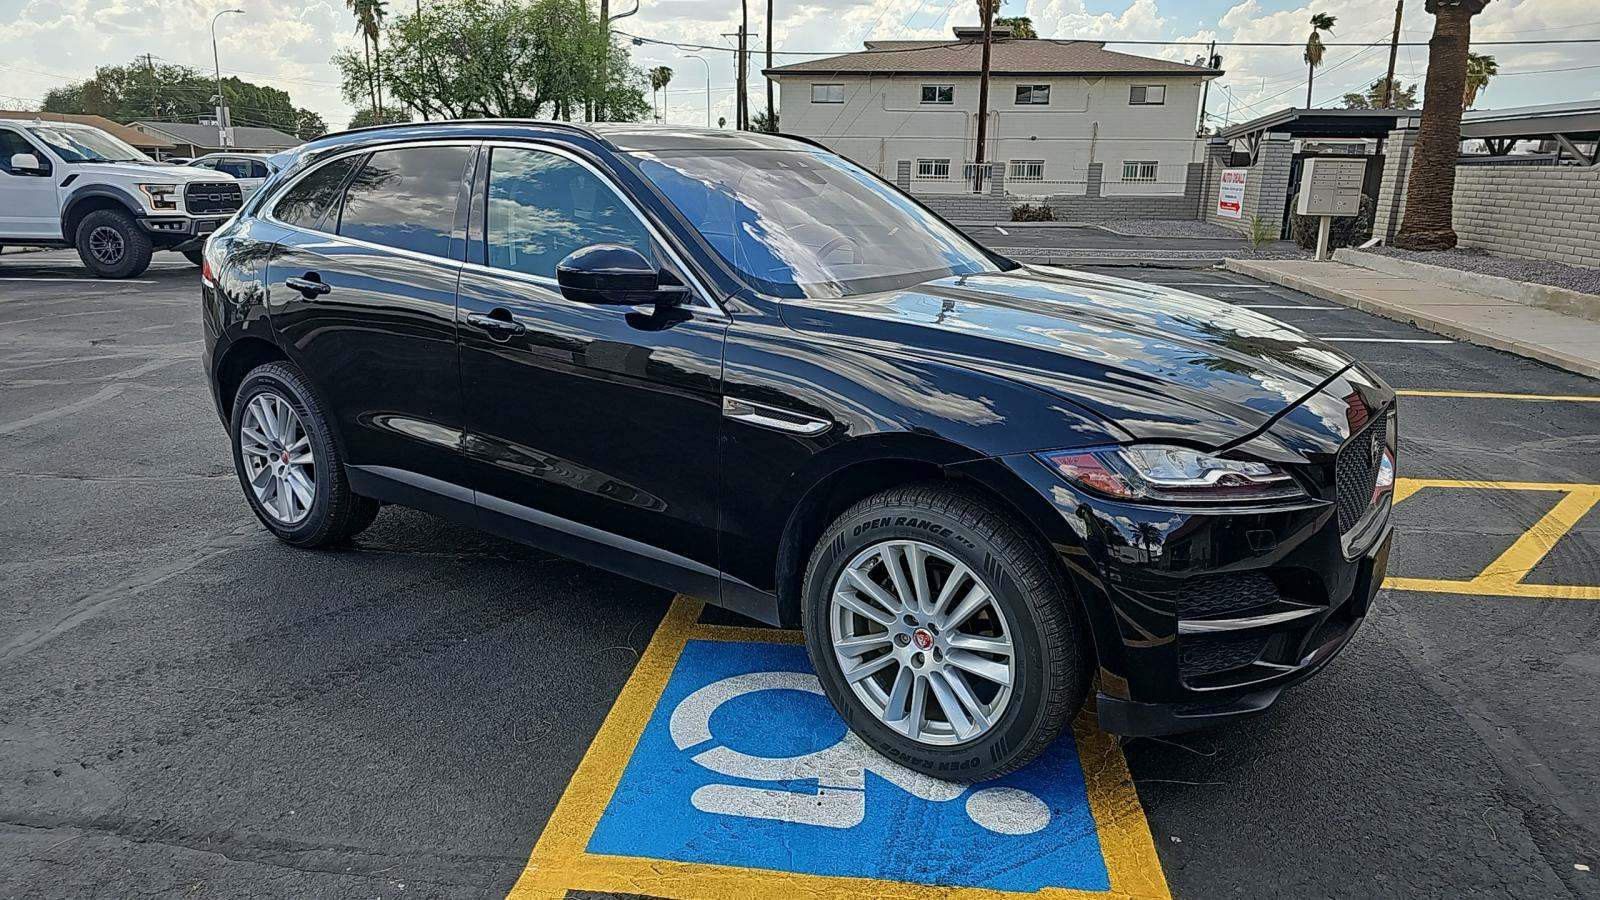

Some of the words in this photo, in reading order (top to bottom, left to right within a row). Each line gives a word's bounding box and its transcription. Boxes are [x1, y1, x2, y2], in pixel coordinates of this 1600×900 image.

[188, 193, 241, 202] FORD
[853, 517, 892, 537] OPEN
[895, 516, 954, 539] RANGE
[880, 742, 934, 770] RANGE
[938, 757, 981, 772] OPEN
